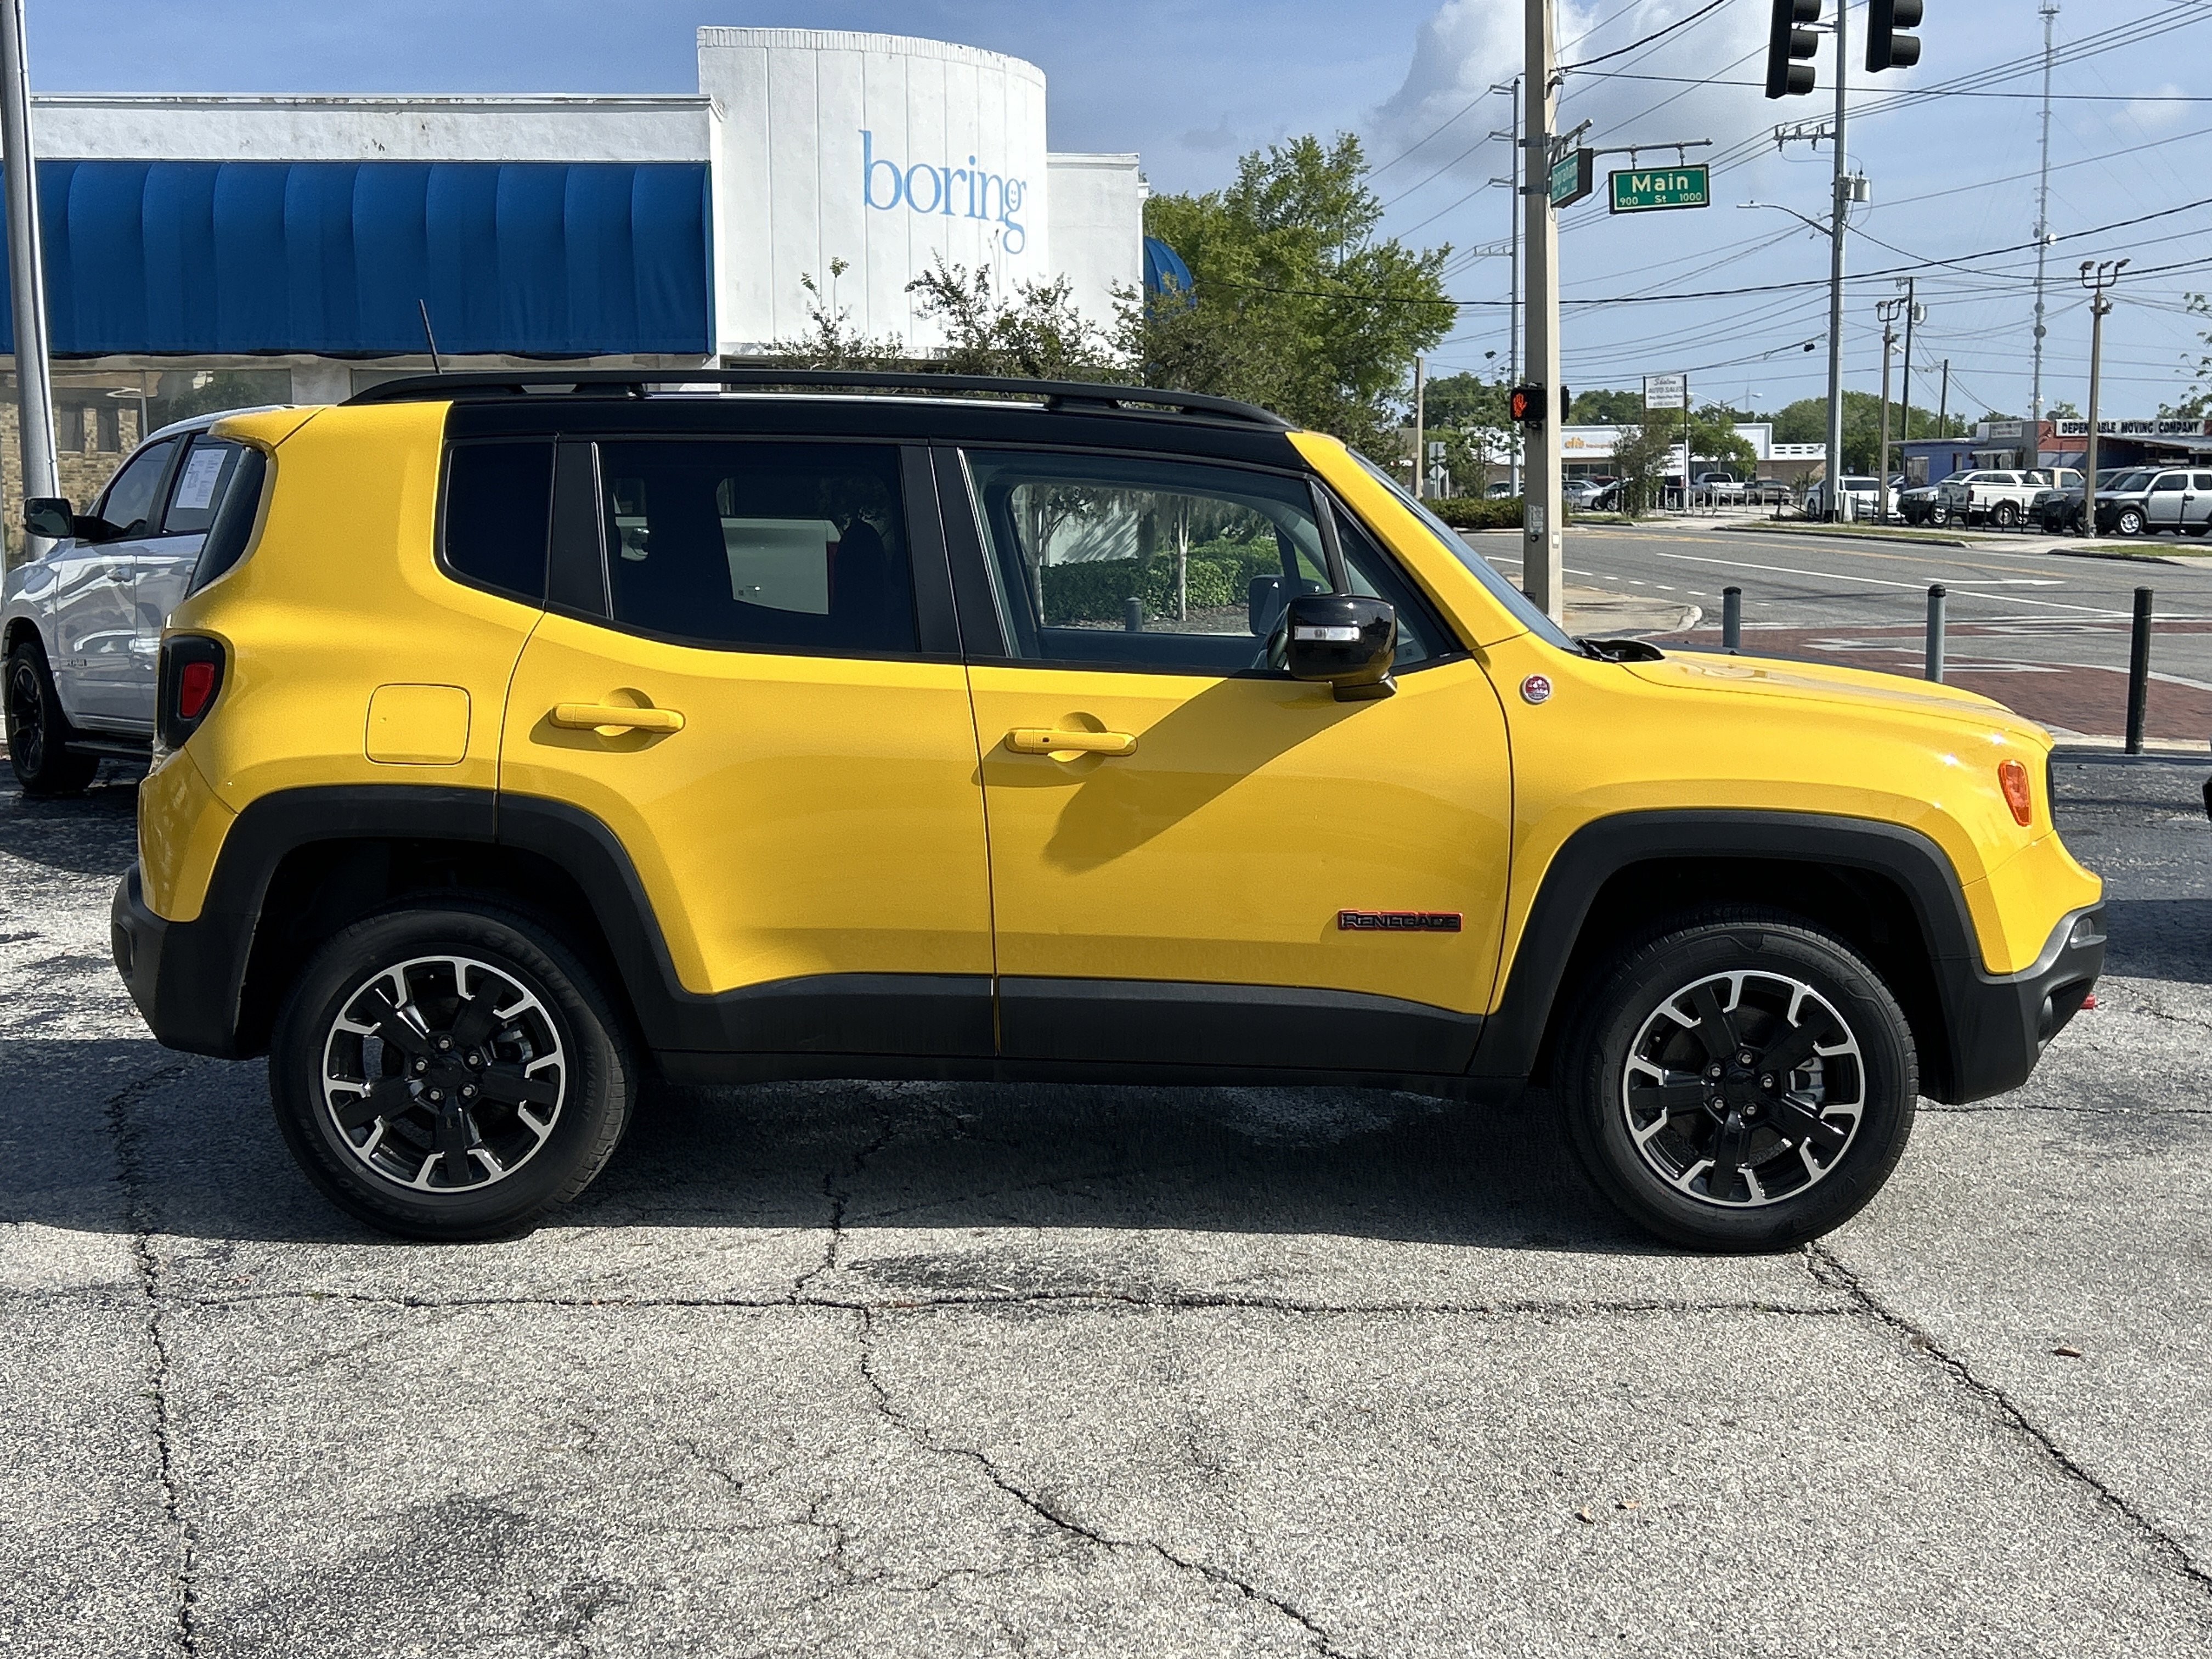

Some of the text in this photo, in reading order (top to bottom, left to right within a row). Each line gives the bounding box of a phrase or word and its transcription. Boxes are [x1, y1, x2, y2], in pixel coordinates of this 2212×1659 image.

[858, 129, 1026, 255] boring
[1632, 173, 1689, 193] Main
[1620, 191, 1702, 206] 900 St 1000
[2062, 421, 2199, 433] DEPENBLE MOVING COMPANY
[1339, 910, 1463, 932] RENEGADE
